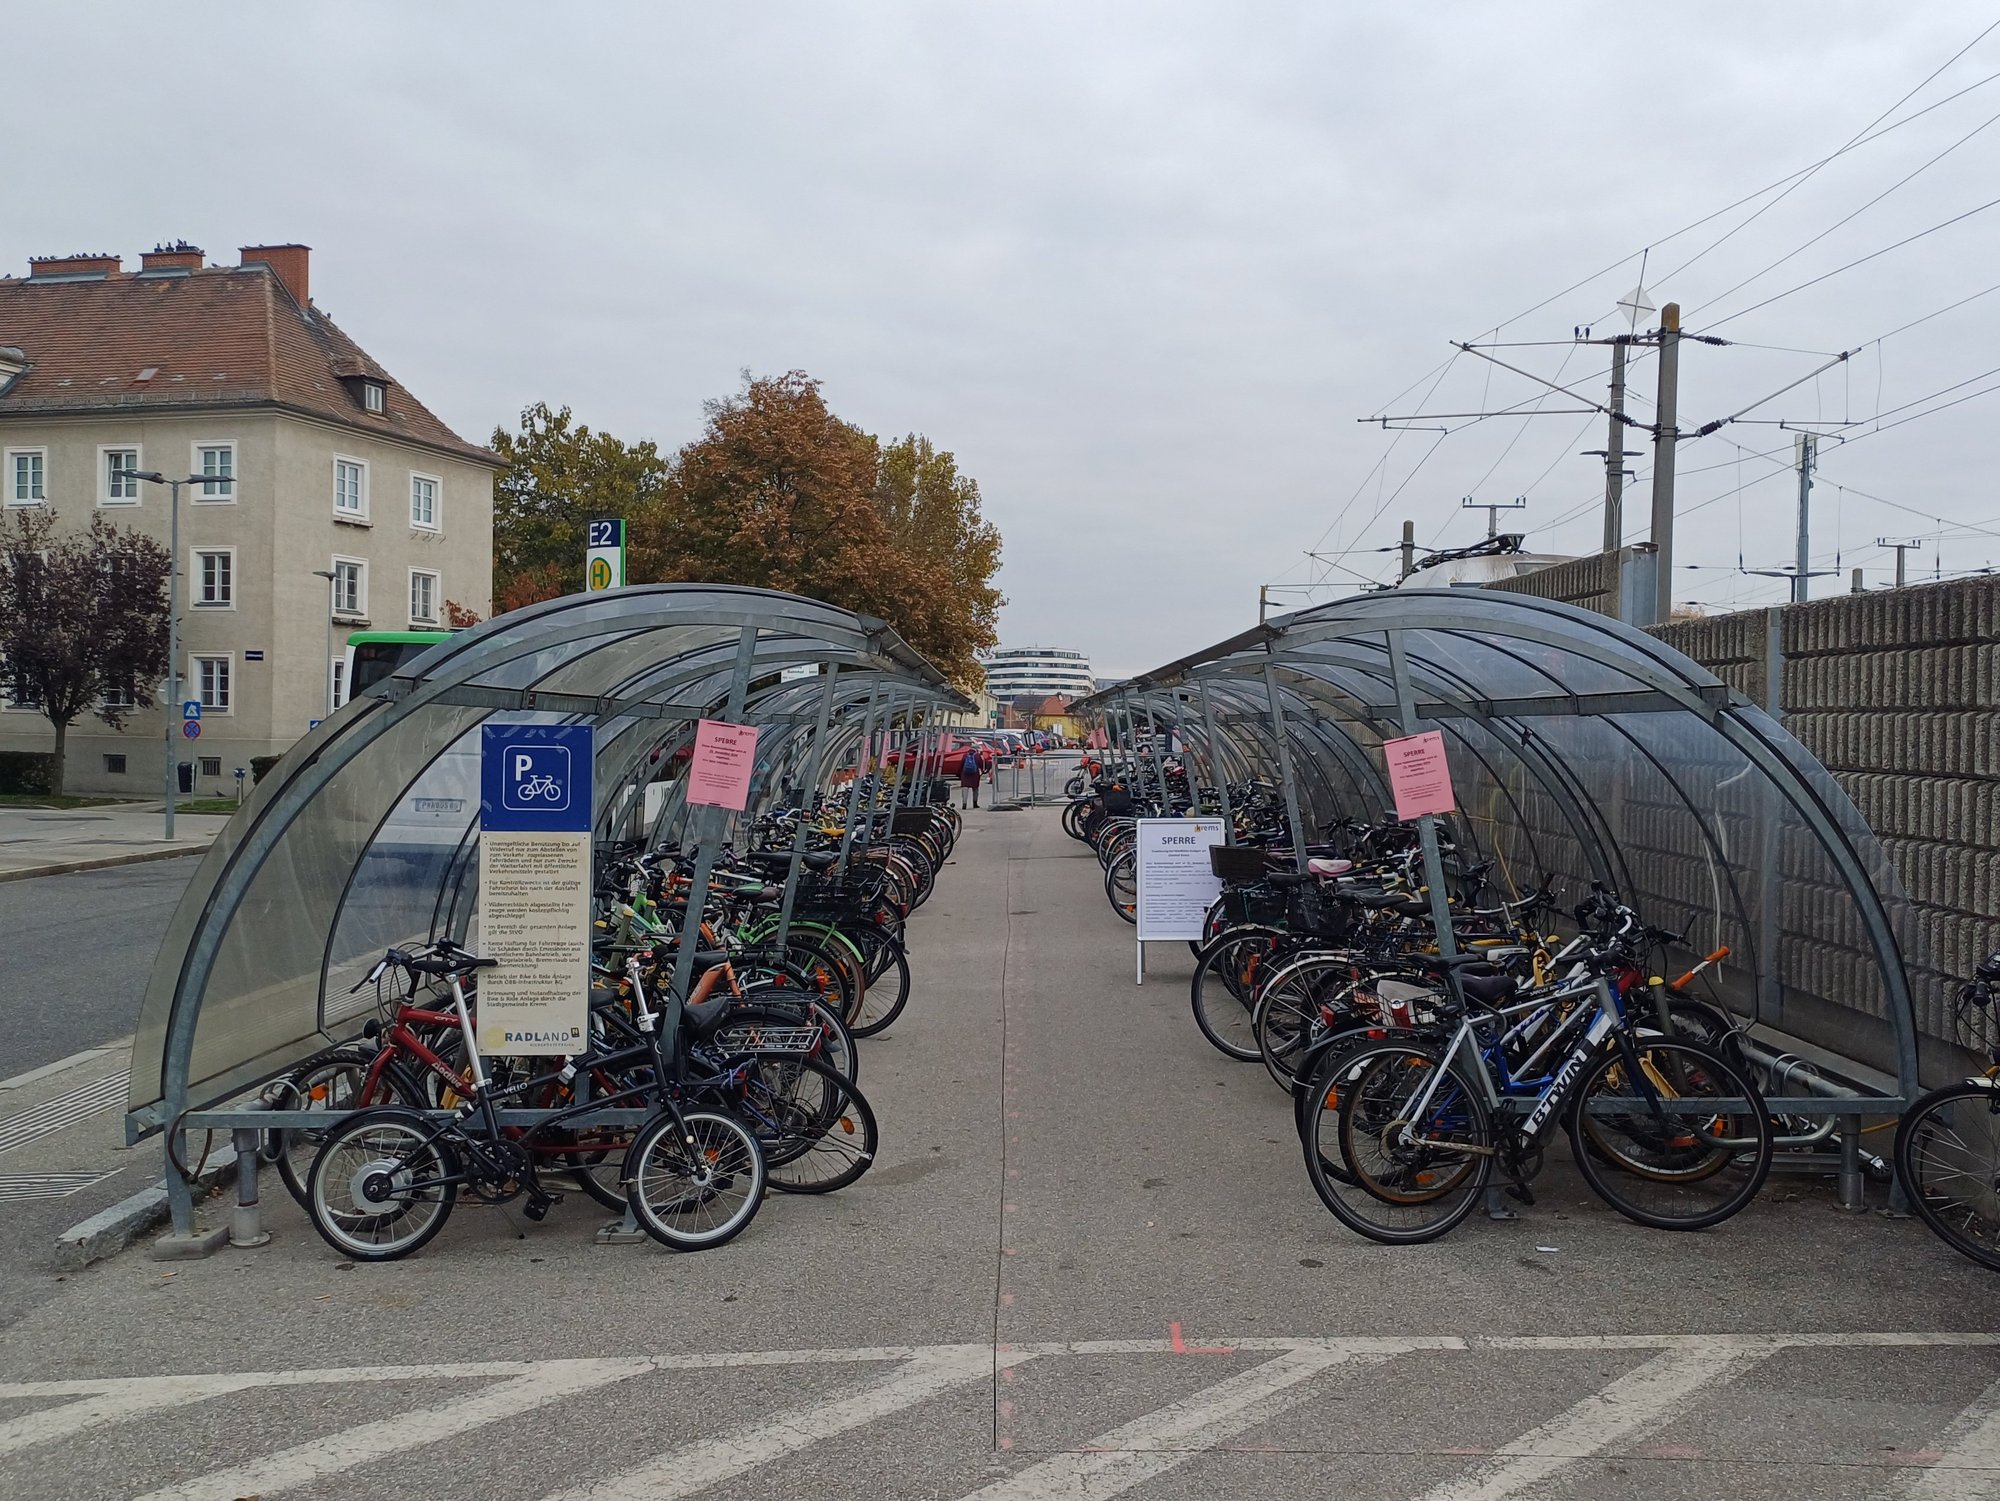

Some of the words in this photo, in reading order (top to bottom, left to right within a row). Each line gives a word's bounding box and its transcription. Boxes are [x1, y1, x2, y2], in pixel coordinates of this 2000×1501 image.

[590, 522, 612, 546] E2
[593, 564, 604, 587] H
[1403, 749, 1425, 757] SPERRE
[515, 755, 532, 781] P
[505, 1032, 569, 1042] RADLAND
[504, 1082, 528, 1094] VELLO
